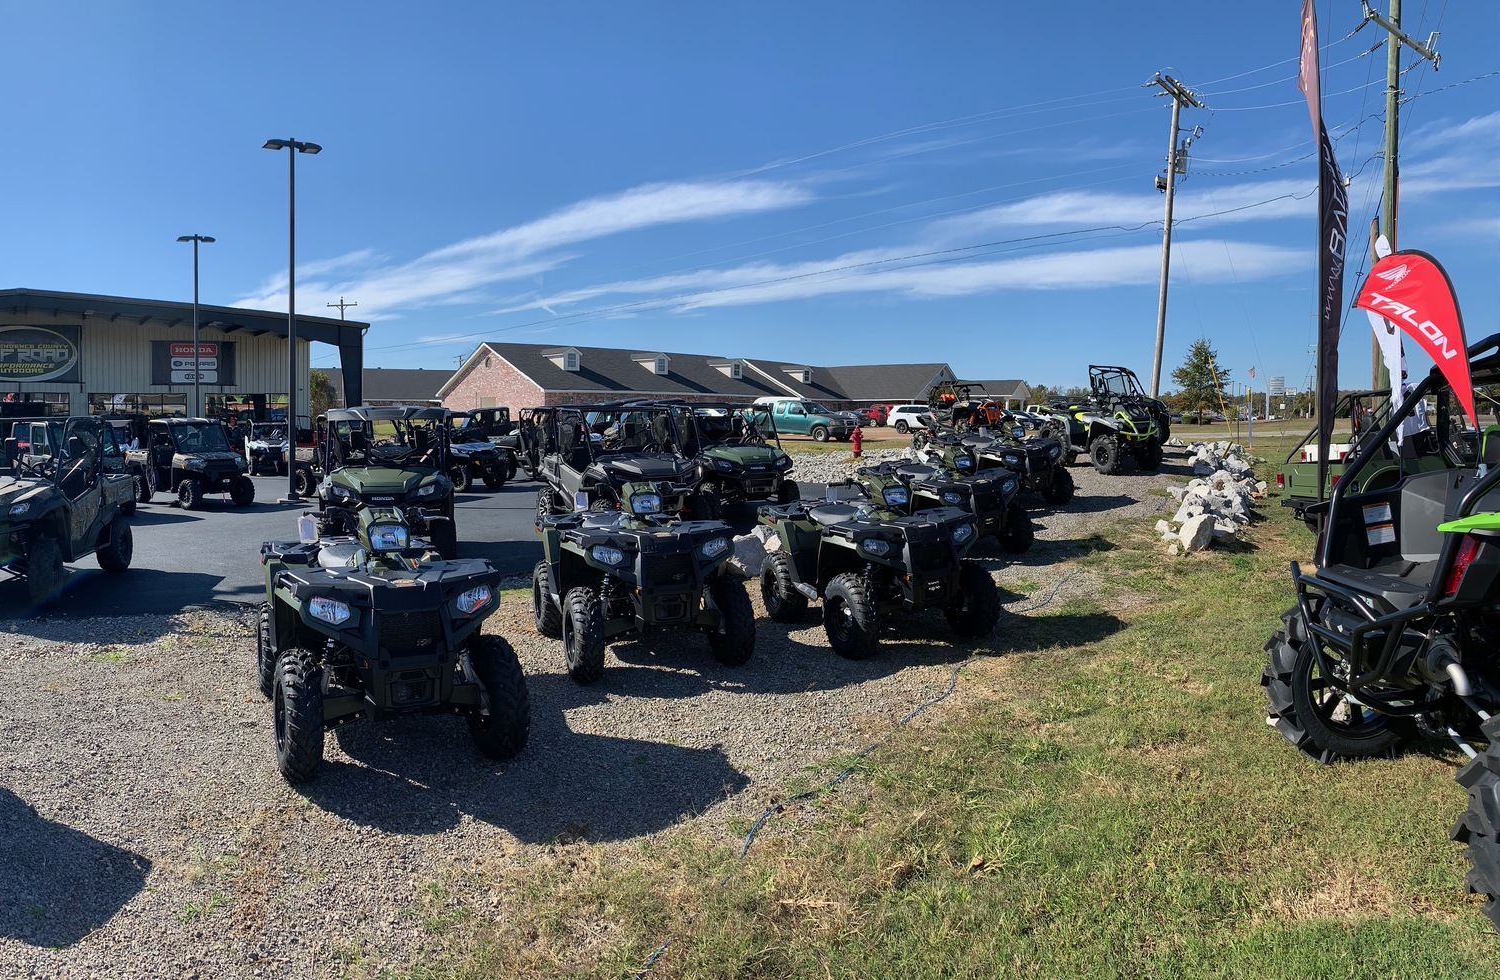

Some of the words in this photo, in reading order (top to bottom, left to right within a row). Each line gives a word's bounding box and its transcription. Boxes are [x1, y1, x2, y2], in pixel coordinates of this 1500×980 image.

[1385, 269, 1412, 290] HONDA
[1370, 291, 1458, 360] TALON
[16, 348, 69, 363] ROAD
